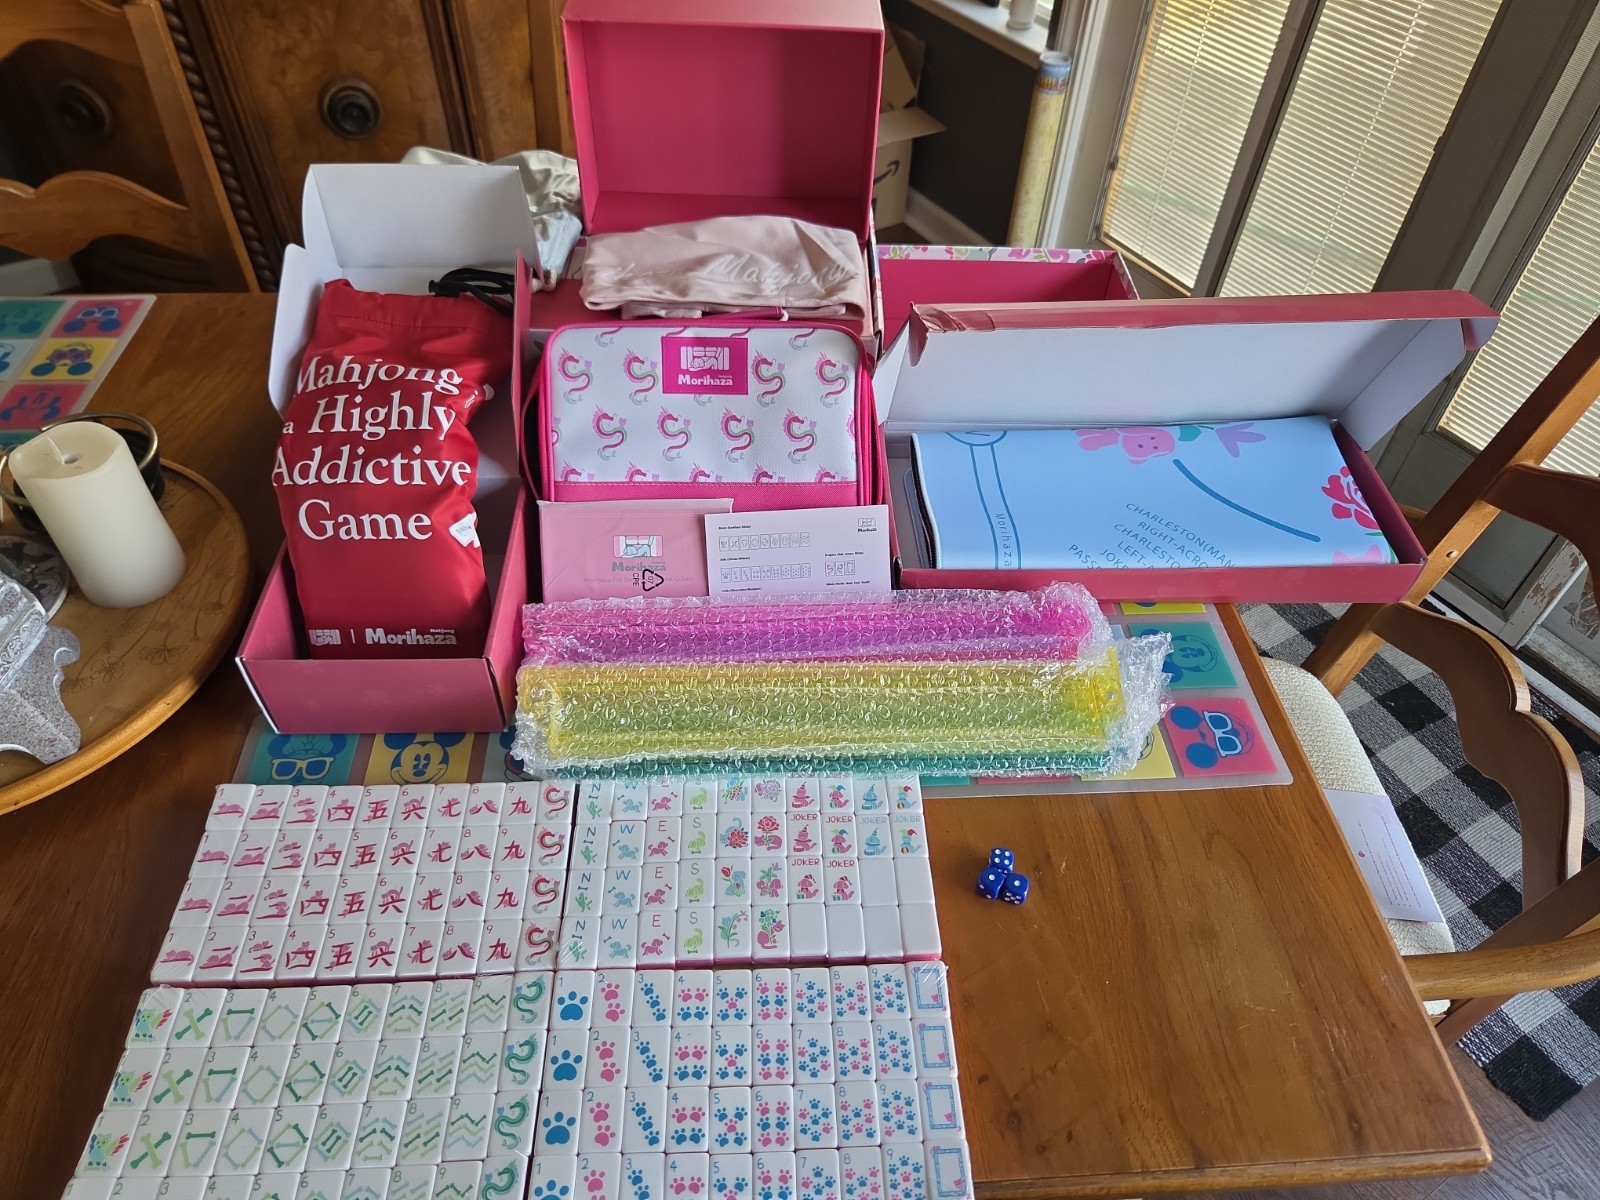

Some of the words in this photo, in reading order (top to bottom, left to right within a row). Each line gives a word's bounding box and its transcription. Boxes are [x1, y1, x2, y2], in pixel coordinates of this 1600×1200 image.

[296, 356, 464, 396] Mahjong
[678, 374, 733, 386] Morihaza
[282, 422, 294, 434] a
[308, 389, 457, 441] Highly
[272, 445, 472, 487] Addictive
[298, 499, 433, 541] Game
[995, 513, 1012, 567] Morihaza
[1068, 544, 1102, 569] PASS
[612, 562, 666, 572] Morihaza
[365, 628, 457, 644] Morihaza
[256, 789, 264, 797] 2
[292, 789, 300, 798] 3
[330, 789, 336, 798] 4
[364, 788, 372, 797] 5
[402, 787, 409, 796] 6
[438, 786, 445, 795] 7
[472, 786, 480, 794] 8
[508, 785, 515, 793] 9
[790, 813, 818, 821] JOKER
[826, 815, 853, 824] JOKER
[859, 817, 886, 825] JOKER
[893, 815, 921, 823] JOKER
[658, 820, 667, 832] E
[693, 816, 701, 829] S
[428, 829, 436, 839] 7
[464, 829, 471, 838] 8
[501, 828, 508, 838] 9
[586, 826, 596, 837] N
[620, 824, 635, 834] W
[240, 834, 248, 842] 2
[279, 833, 286, 842] 3
[316, 833, 324, 842] 4
[352, 832, 360, 841] 5
[390, 831, 398, 840] 6
[791, 858, 820, 867] JOKER
[826, 860, 855, 868] JOKER
[655, 866, 664, 879] E
[691, 862, 700, 875] S
[455, 875, 463, 885] 8
[494, 874, 501, 884] 9
[581, 872, 591, 883] N
[616, 870, 631, 881] W
[224, 881, 233, 891] 2
[264, 880, 272, 890] 3
[303, 880, 310, 889] 4
[340, 879, 348, 888] 5
[379, 877, 387, 887] 6
[418, 876, 426, 886] 7
[652, 914, 661, 928] E
[689, 911, 698, 924] S
[575, 920, 586, 931] N
[611, 918, 627, 930] W
[289, 930, 297, 940] 4
[328, 929, 336, 939] 5
[368, 927, 376, 938] 6
[409, 927, 416, 937] 7
[446, 926, 454, 936] 8
[486, 925, 494, 935] 9
[208, 931, 217, 941] 2
[248, 931, 257, 941] 3
[755, 972, 762, 982] 6
[834, 970, 841, 980] 8
[872, 968, 878, 977] 9
[598, 973, 606, 983] 2
[639, 973, 645, 983] 3
[678, 975, 686, 985] 4
[716, 976, 723, 984] 5
[795, 973, 801, 983] 7
[435, 983, 443, 993] 8
[476, 981, 482, 990] 9
[269, 991, 277, 1001] 4
[309, 991, 317, 1001] 5
[352, 987, 360, 997] 6
[394, 986, 402, 996] 7
[183, 992, 193, 1003] 2
[226, 992, 235, 1003] 3
[756, 1029, 763, 1039] 6
[797, 1029, 803, 1039] 7
[837, 1027, 844, 1036] 8
[876, 1025, 883, 1035] 9
[593, 1031, 600, 1041] 2
[634, 1032, 640, 1042] 3
[675, 1032, 682, 1042] 4
[715, 1031, 721, 1040] 5
[423, 1042, 430, 1052] 8
[465, 1038, 473, 1048] 9
[292, 1047, 301, 1058] 5
[335, 1047, 344, 1057] 6
[380, 1045, 388, 1055] 7
[162, 1053, 172, 1064] 2
[208, 1051, 216, 1063] 3
[250, 1051, 258, 1061] 4
[839, 1087, 847, 1097] 8
[880, 1084, 886, 1094] 9
[587, 1092, 595, 1102] 2
[629, 1092, 636, 1102] 3
[671, 1092, 679, 1103] 4
[714, 1093, 721, 1104] 5
[755, 1091, 763, 1101] 6
[798, 1090, 804, 1099] 7
[409, 1103, 417, 1114] 8
[453, 1098, 461, 1109] 9
[275, 1110, 283, 1121] 5
[319, 1108, 328, 1119] 6
[365, 1106, 373, 1117] 7
[140, 1114, 150, 1126] 2
[185, 1113, 195, 1125] 3
[232, 1112, 240, 1124] 4
[843, 1153, 851, 1164] 8
[886, 1149, 893, 1160] 9
[581, 1158, 589, 1169] 2
[625, 1158, 633, 1170] 3
[669, 1160, 678, 1171] 4
[757, 1158, 765, 1169] 6
[801, 1156, 807, 1168] 7
[439, 1167, 447, 1178] 9
[713, 1162, 720, 1173] 5
[349, 1173, 356, 1186] 7
[393, 1171, 402, 1182] 8
[208, 1180, 217, 1192] 4
[252, 1179, 262, 1191] 5
[300, 1176, 309, 1188] 6
[112, 1183, 123, 1195] 2
[160, 1182, 170, 1195] 3
